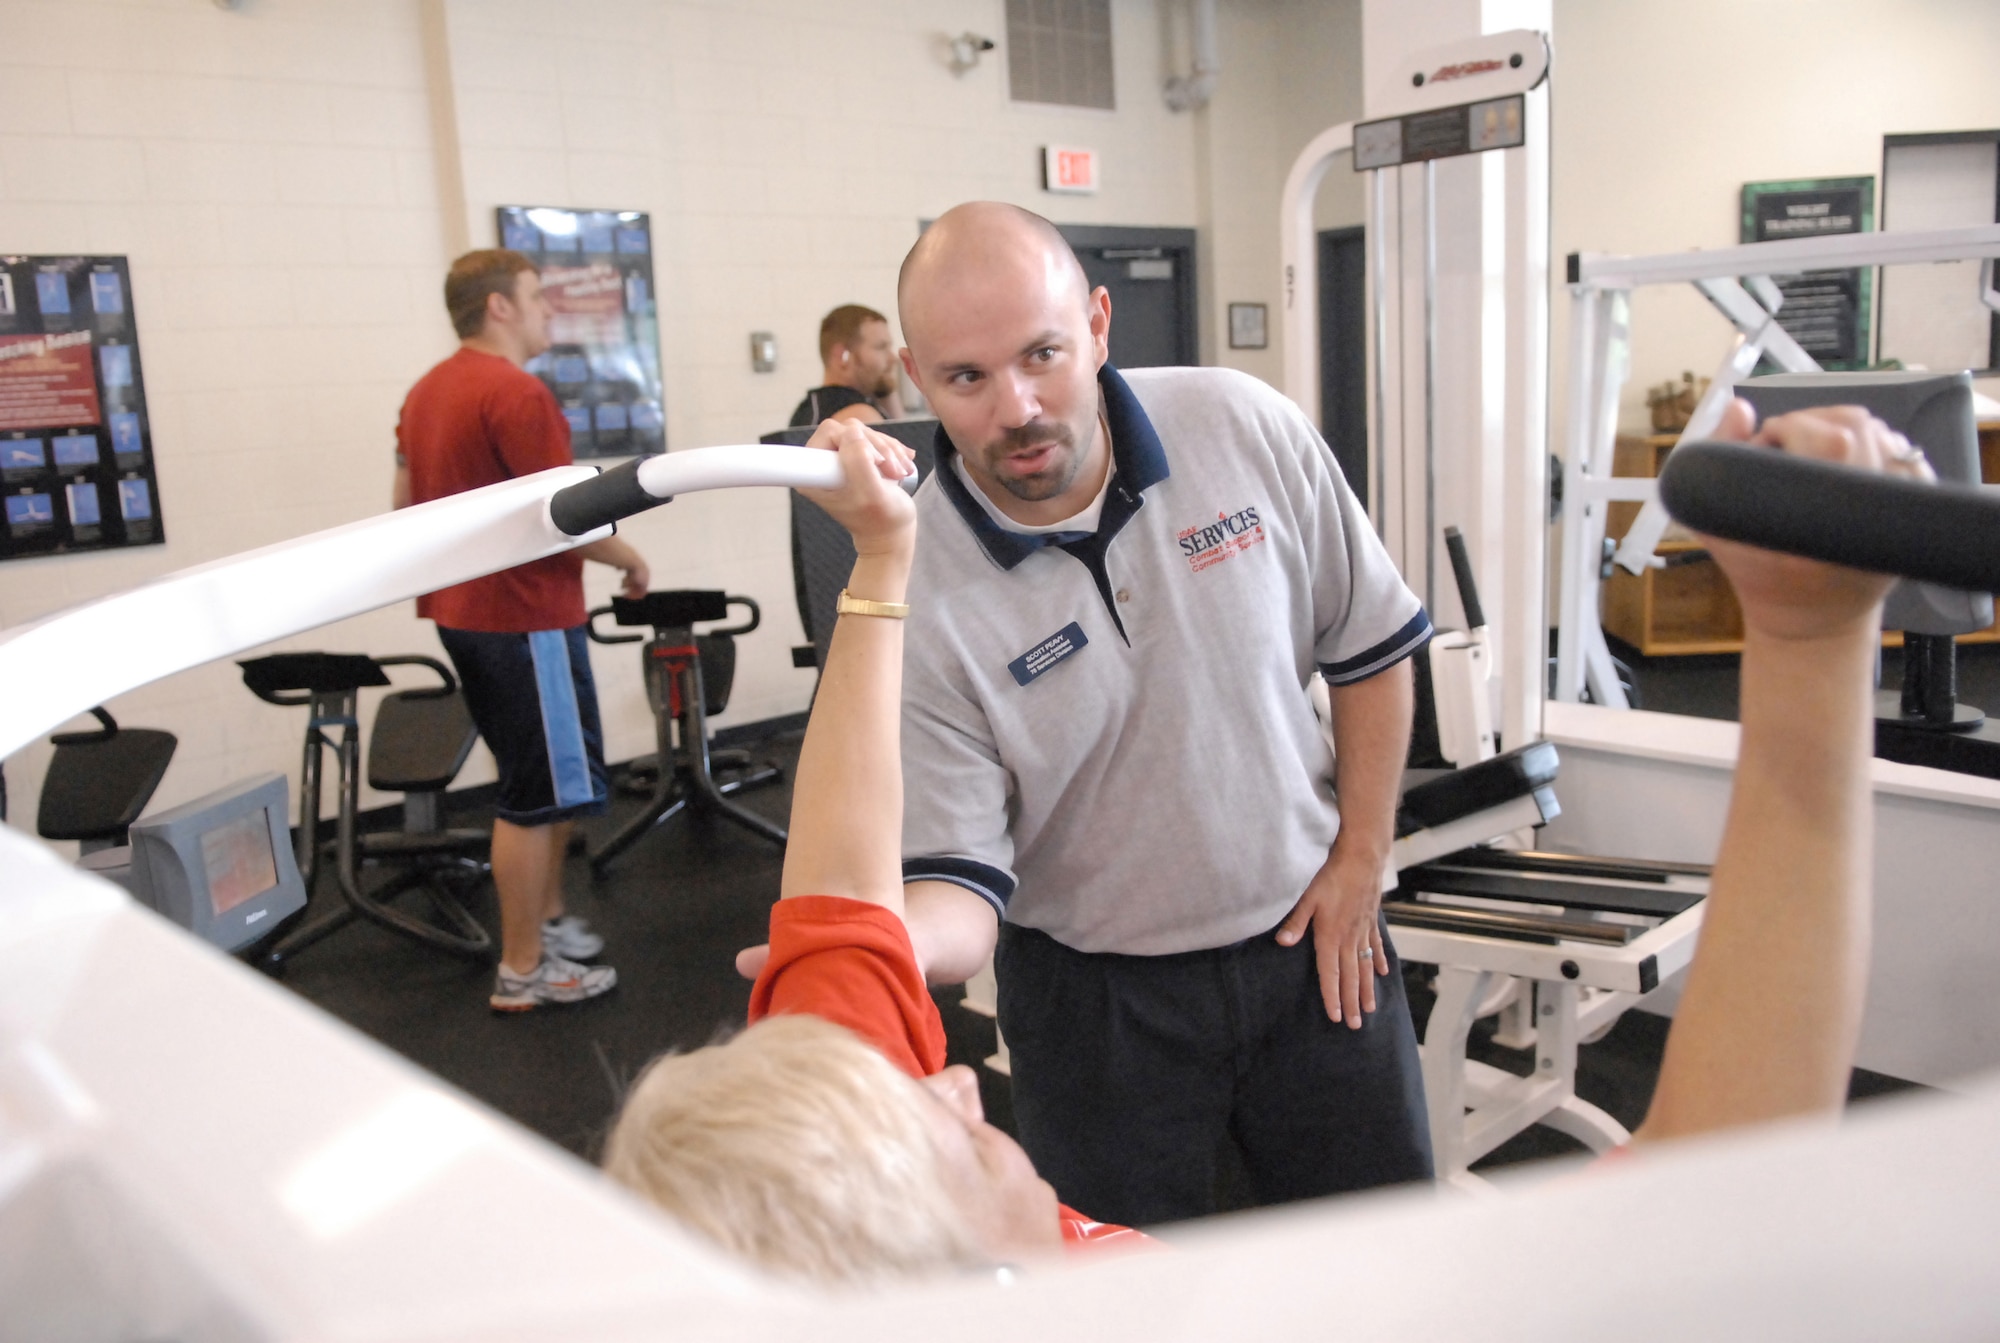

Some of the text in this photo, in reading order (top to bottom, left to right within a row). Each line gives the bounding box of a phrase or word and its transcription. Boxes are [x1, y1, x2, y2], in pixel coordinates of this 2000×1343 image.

[1179, 506, 1260, 557] SERVICES
[1189, 545, 1223, 565] Combat
[1191, 535, 1265, 573] Community Service
[1025, 646, 1046, 663] SCOTT
[1036, 656, 1057, 671] Services
[1055, 644, 1074, 659] Division
